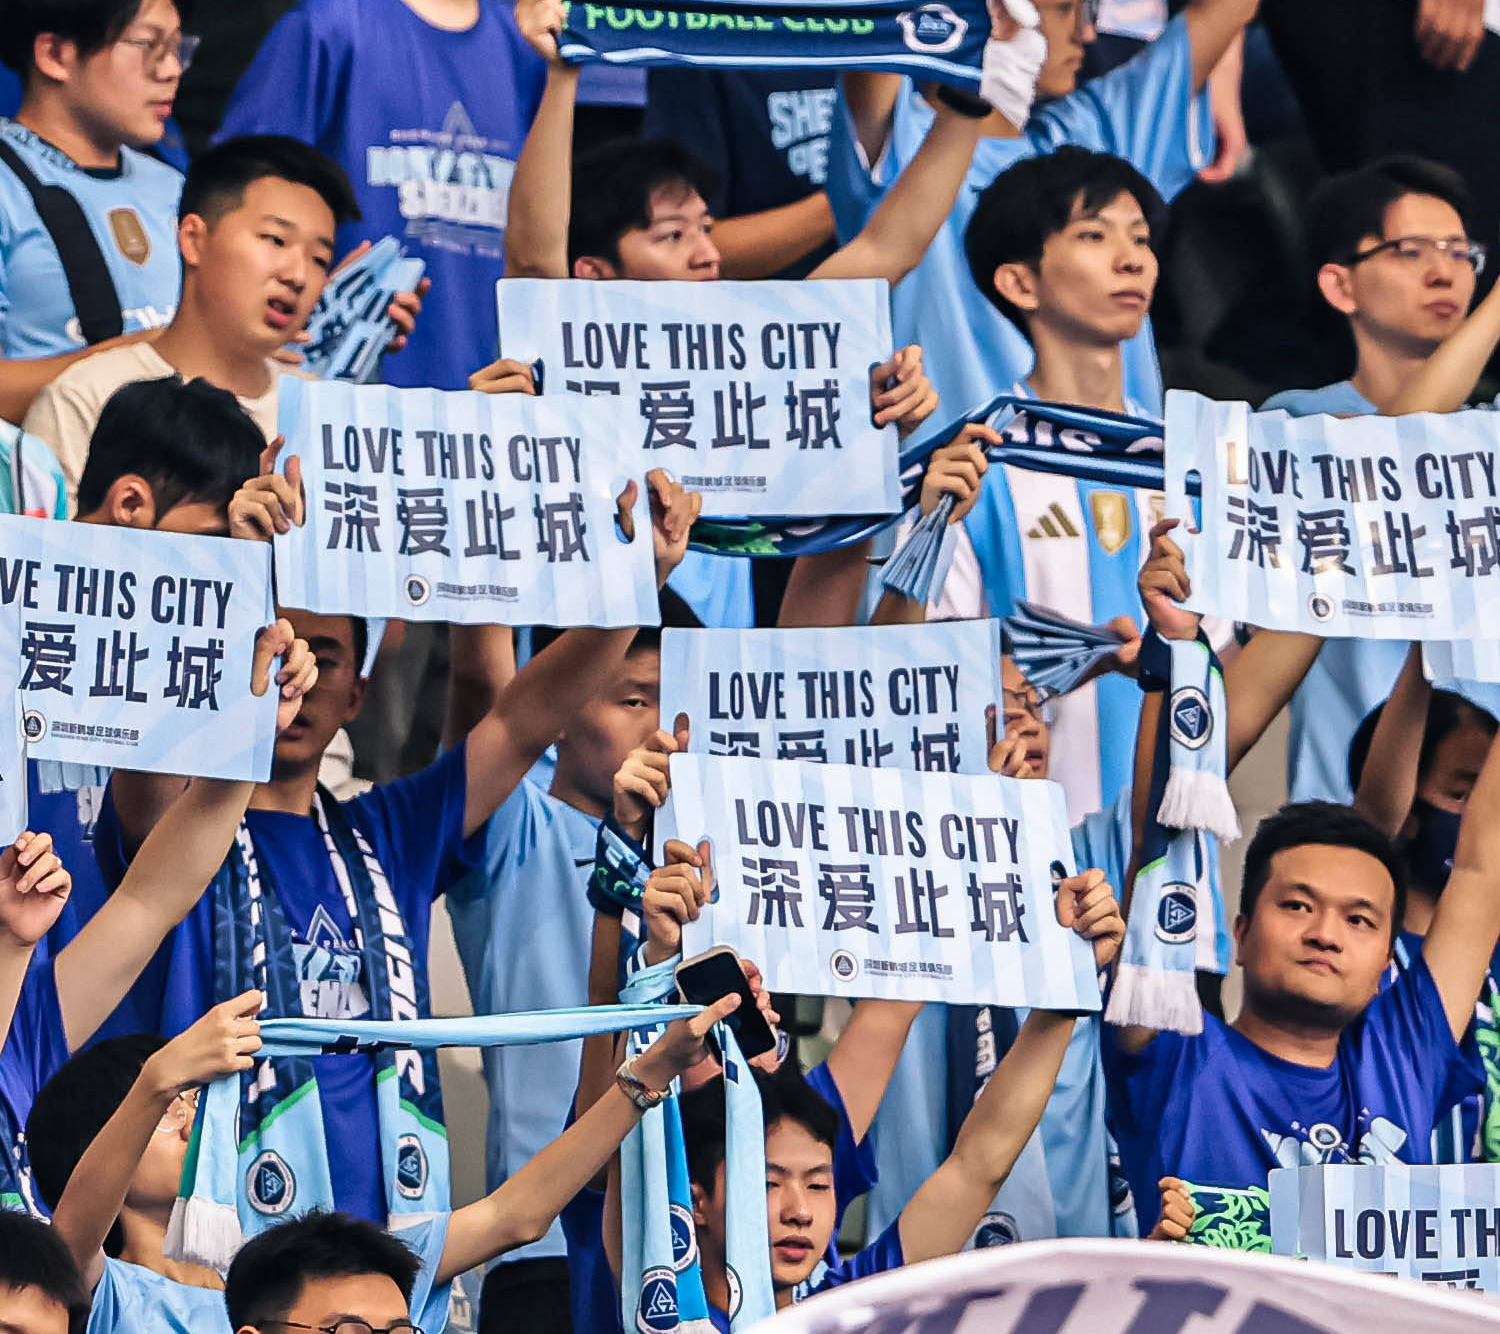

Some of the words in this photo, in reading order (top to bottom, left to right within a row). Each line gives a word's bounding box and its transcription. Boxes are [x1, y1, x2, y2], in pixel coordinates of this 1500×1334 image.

[562, 322, 650, 369] LOVE
[661, 323, 746, 370] THIS
[761, 323, 840, 370] CITY
[54, 564, 136, 620] THIS
[151, 575, 233, 629] CITY
[735, 799, 829, 851] LOVE
[838, 807, 926, 858] THIS
[940, 814, 1018, 864] CITY
[742, 857, 1030, 943] 深爱此城
